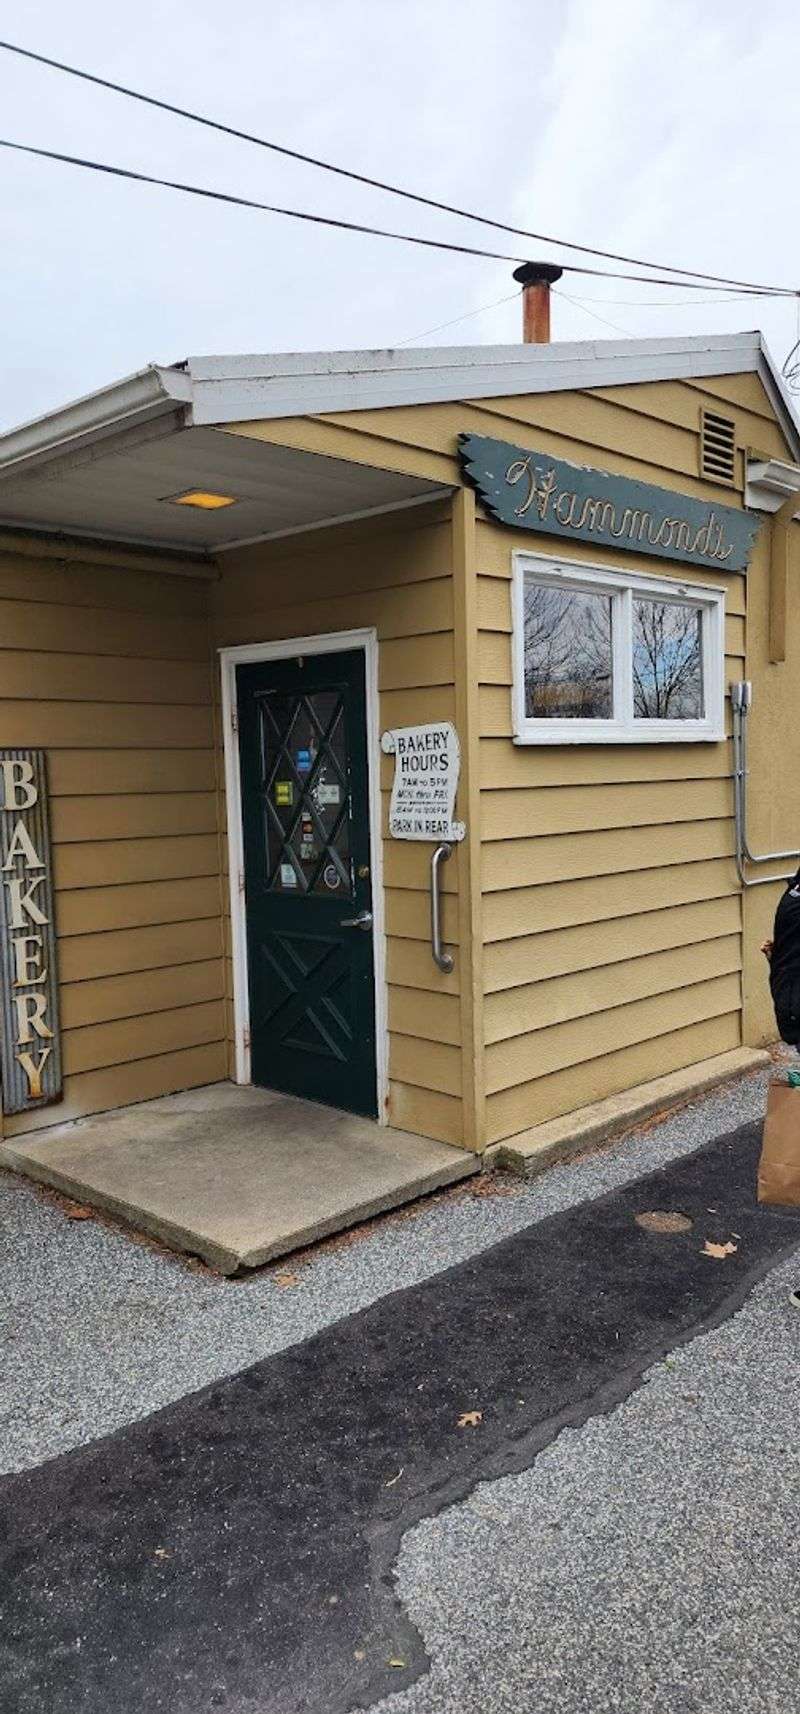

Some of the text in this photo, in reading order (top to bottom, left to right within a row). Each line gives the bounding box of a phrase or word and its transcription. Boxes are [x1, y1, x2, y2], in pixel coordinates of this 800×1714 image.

[398, 731, 449, 754] BAKERY
[401, 753, 449, 772] HOURS
[393, 819, 449, 834] PARK IN REAR
[0, 760, 55, 1099] BAKERY
